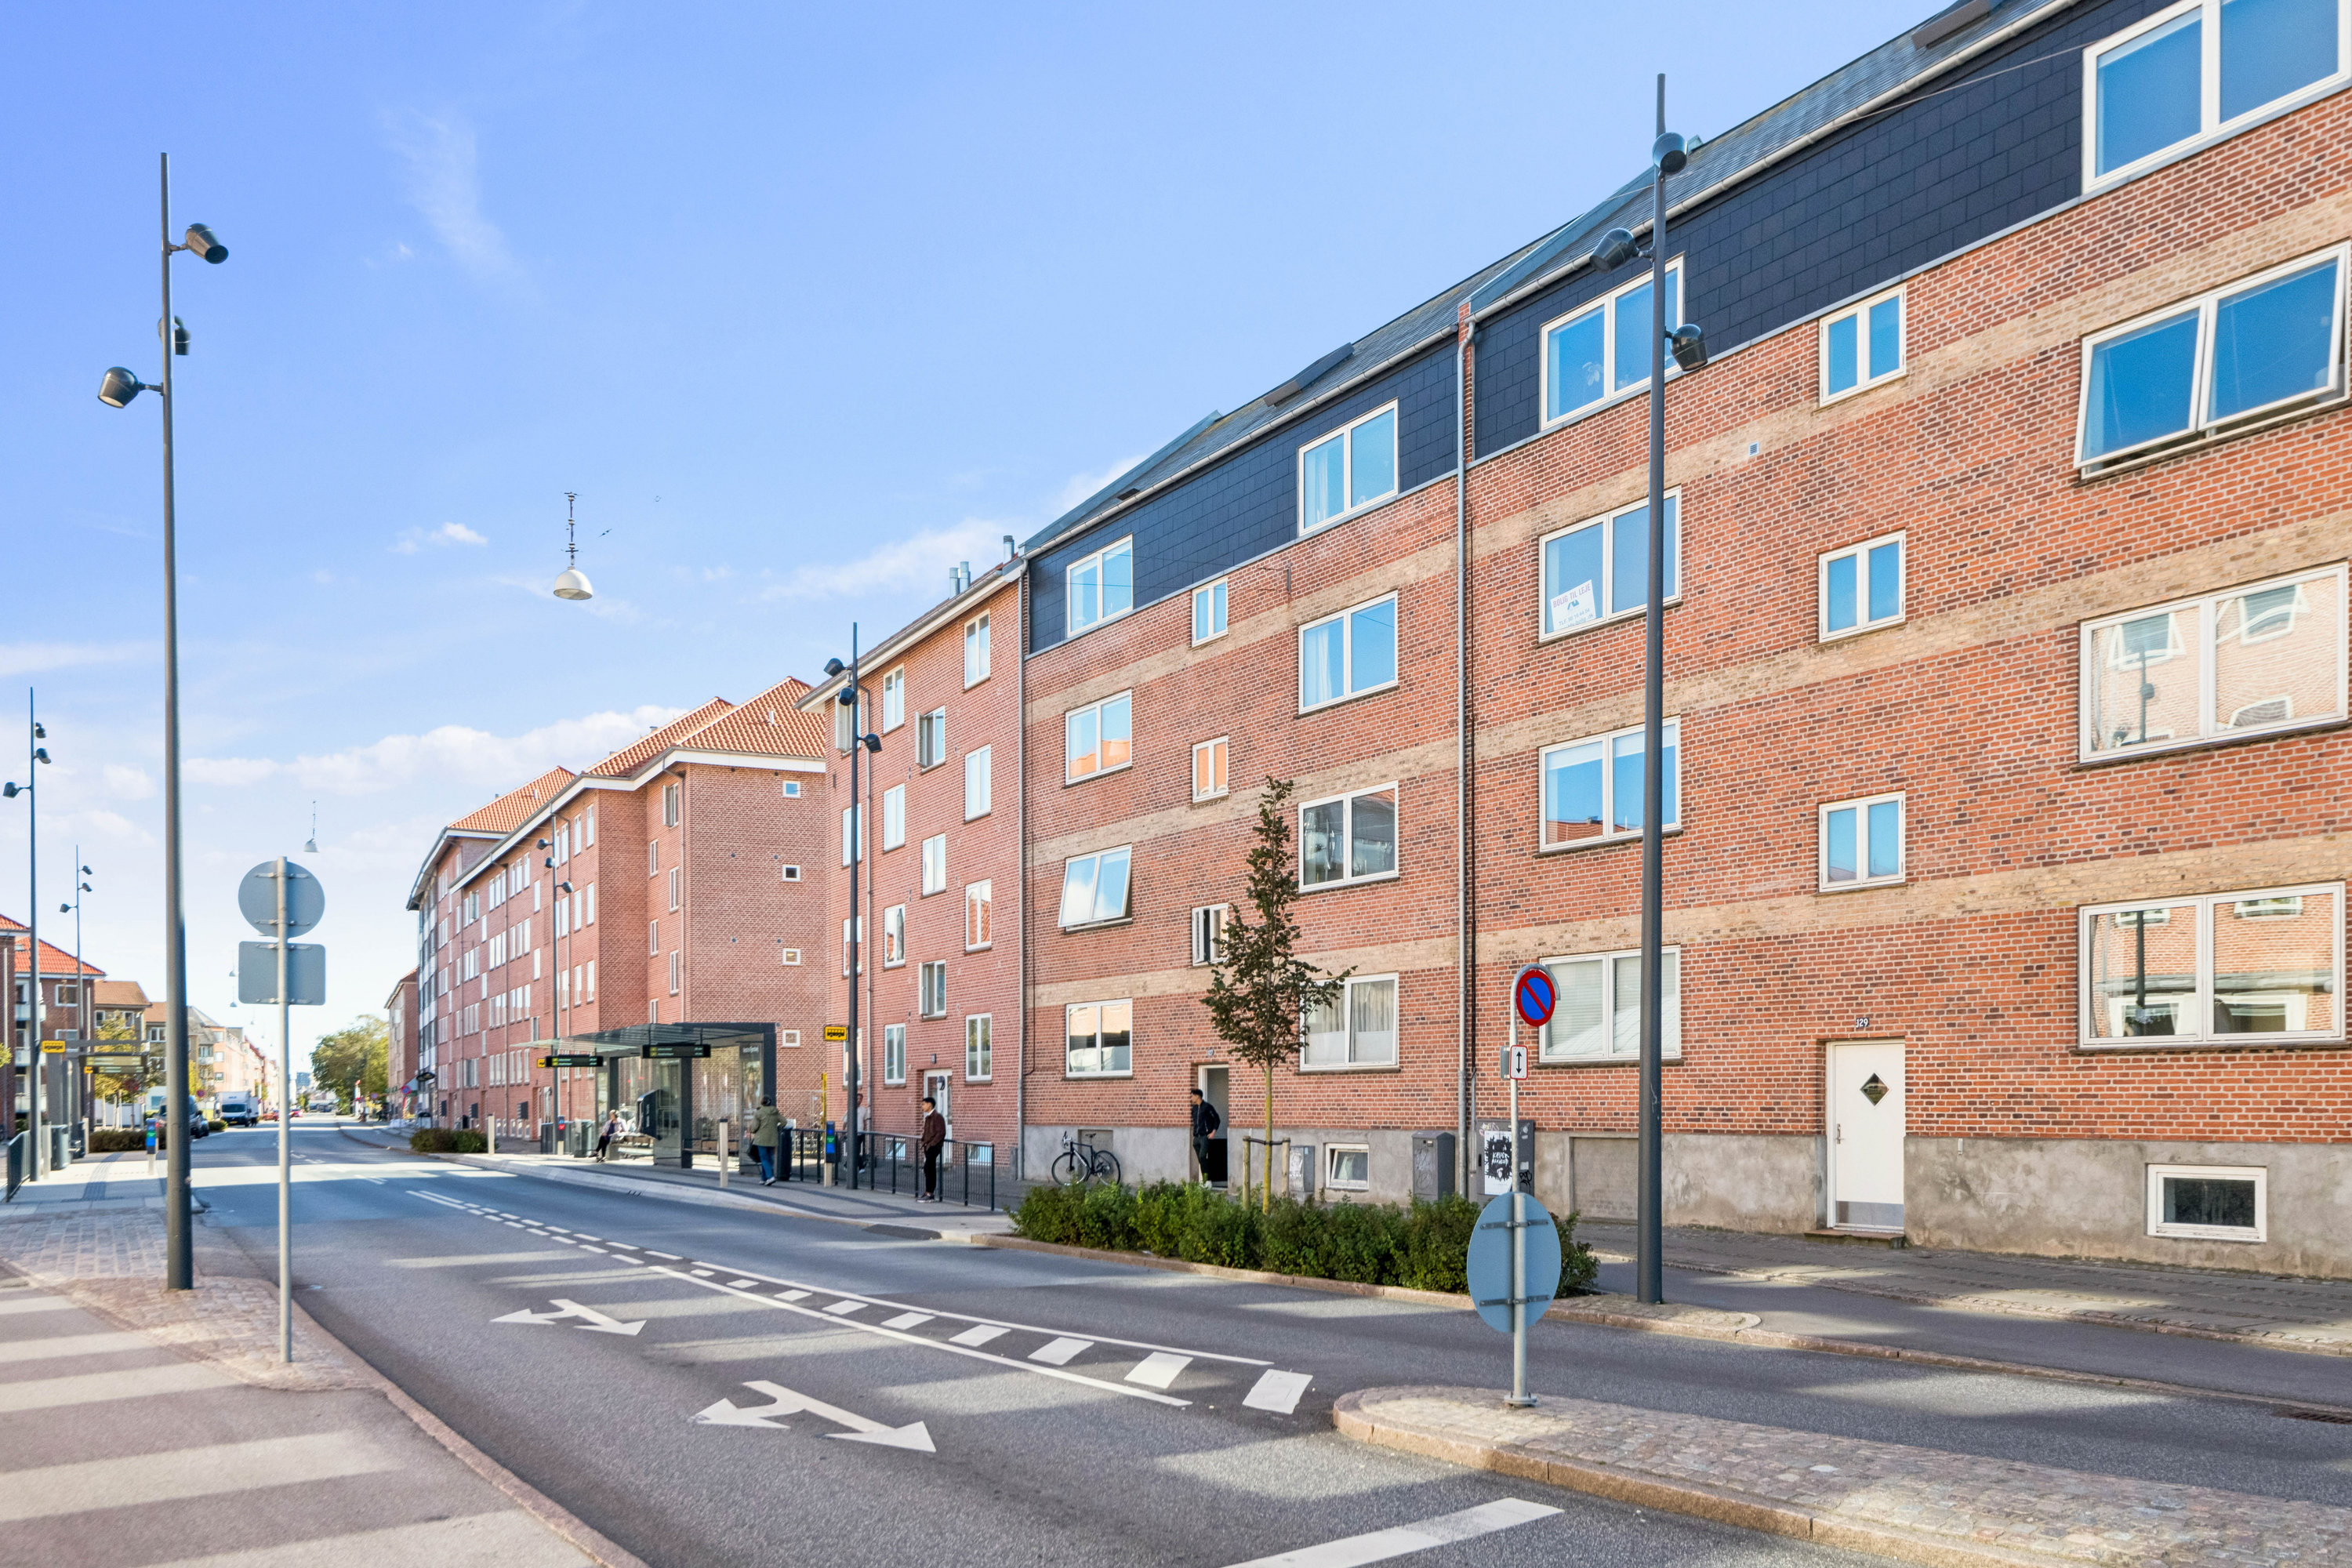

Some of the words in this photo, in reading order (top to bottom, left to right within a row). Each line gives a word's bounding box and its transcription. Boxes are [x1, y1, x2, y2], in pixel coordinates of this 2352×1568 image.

[1553, 595, 1568, 608] BOLIG
[1579, 583, 1591, 595] LEJE
[1856, 1018, 1868, 1028] 129
